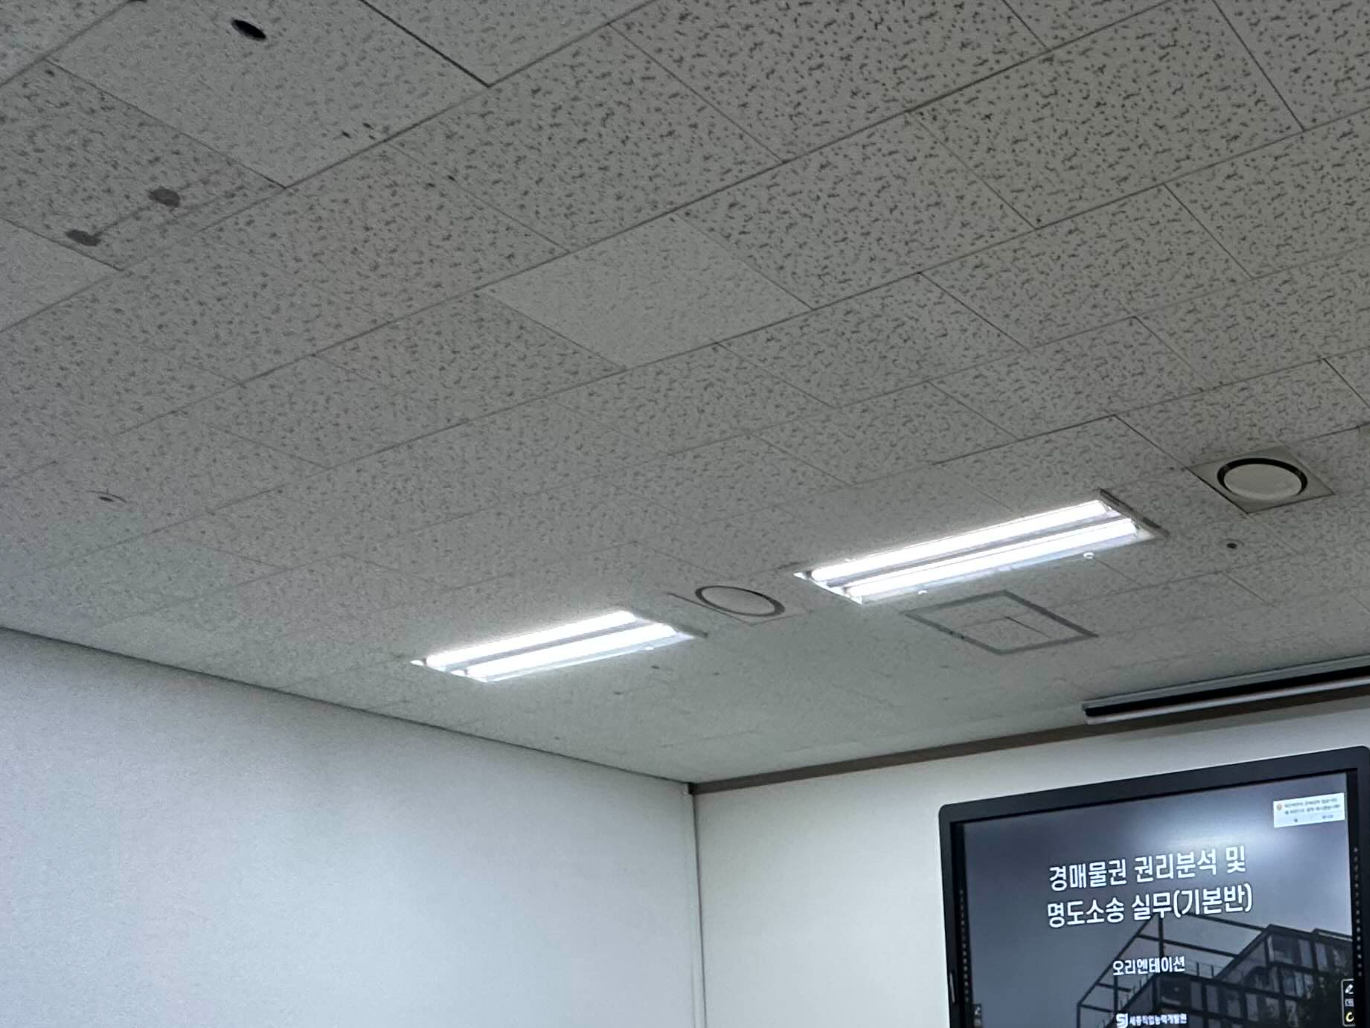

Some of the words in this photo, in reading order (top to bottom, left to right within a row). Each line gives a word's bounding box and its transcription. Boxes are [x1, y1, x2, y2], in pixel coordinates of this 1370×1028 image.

[1049, 859, 1127, 891] 경매물권
[1134, 849, 1217, 883] 권리분석
[1225, 845, 1246, 873] 및
[1047, 897, 1125, 928] 명도소송
[1131, 883, 1253, 921] 실무(기본반)
[1112, 956, 1186, 976] 오리엔테이션
